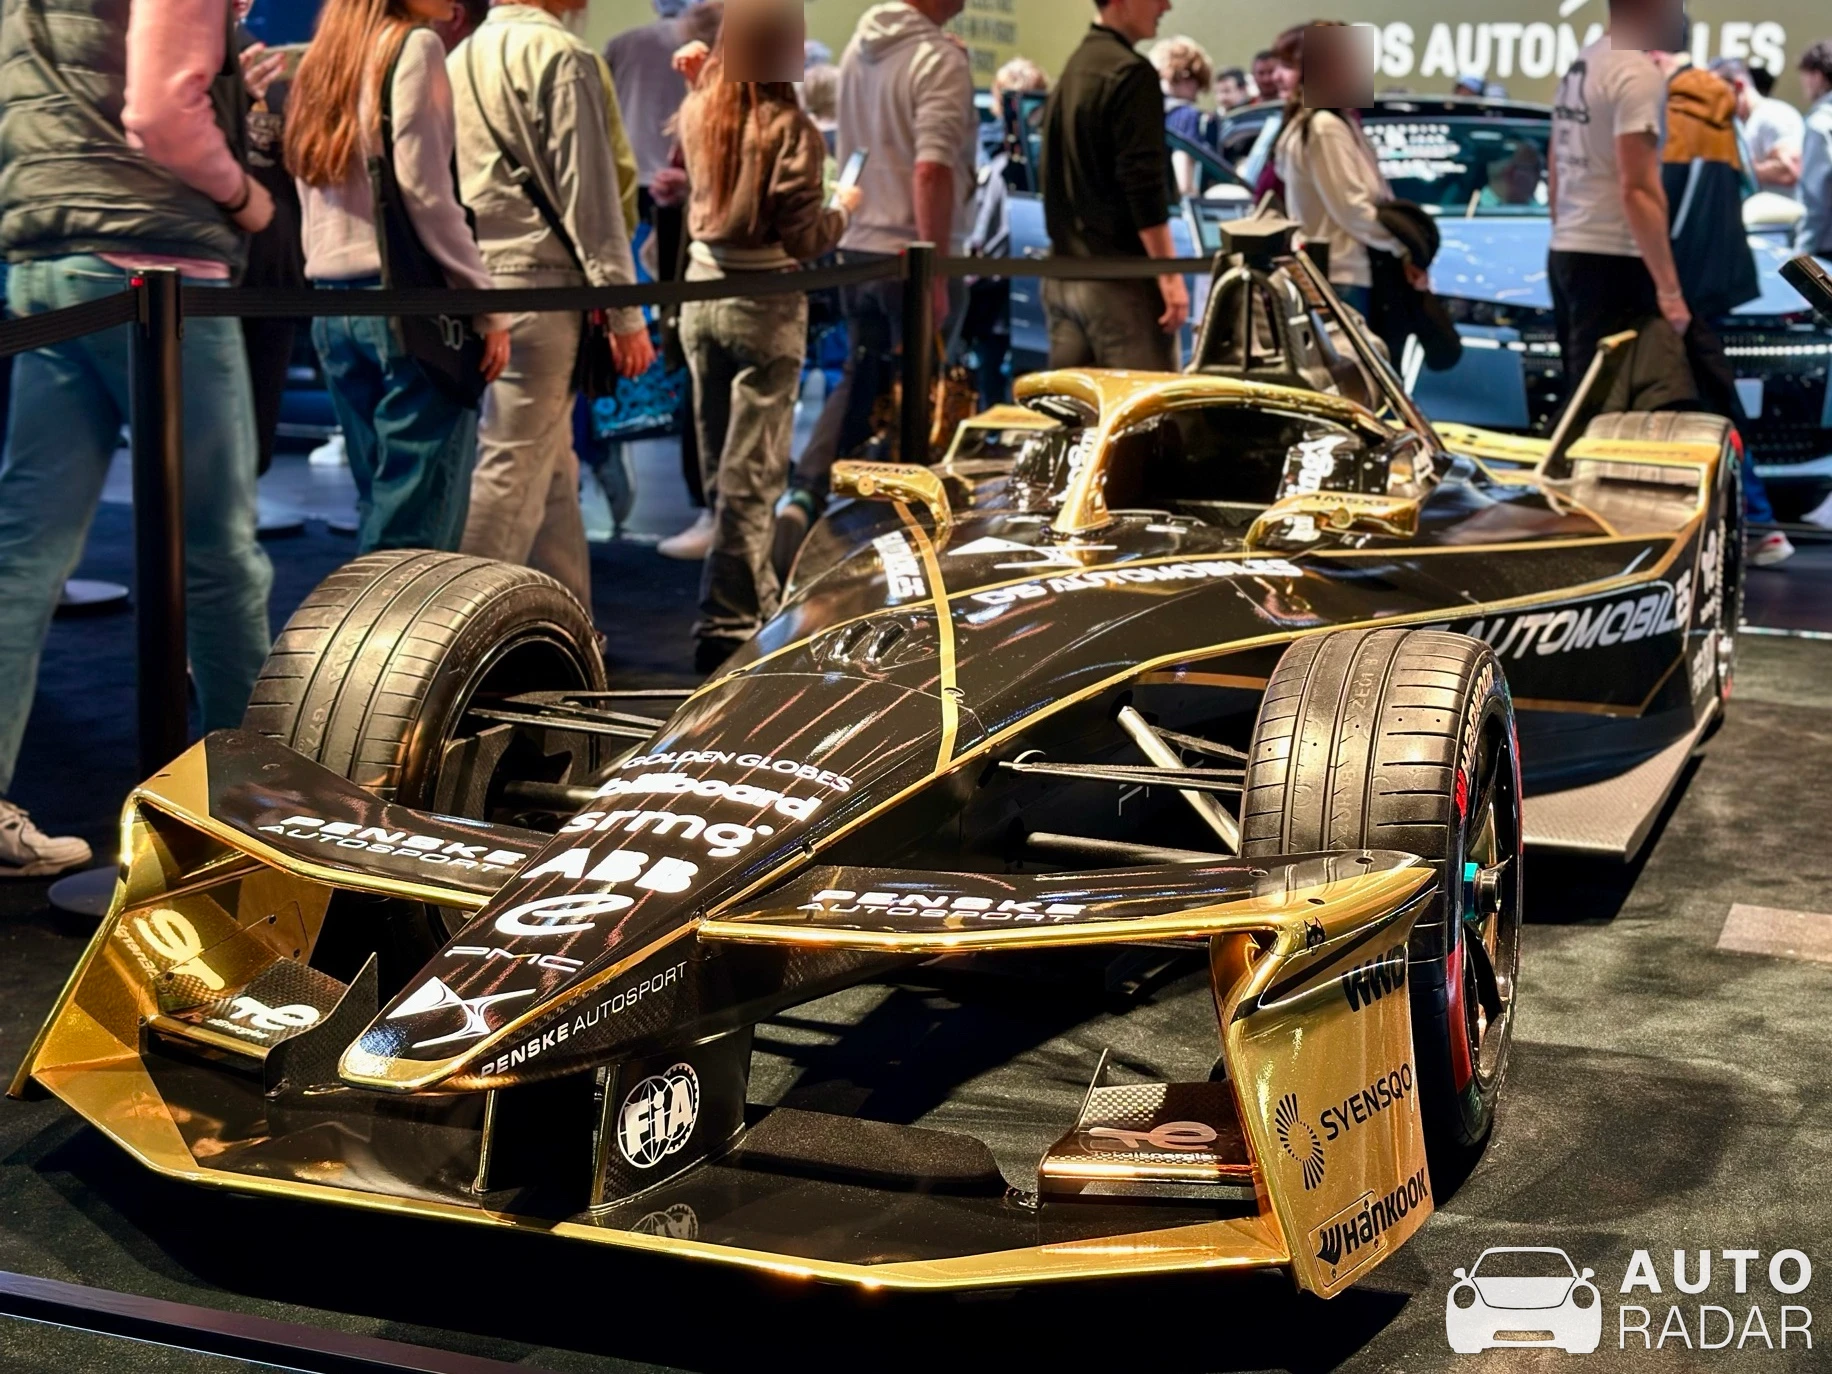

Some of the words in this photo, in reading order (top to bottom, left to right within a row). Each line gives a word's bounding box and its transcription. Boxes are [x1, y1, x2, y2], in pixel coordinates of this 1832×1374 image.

[621, 750, 736, 770] GOLDEN
[736, 753, 853, 792] GLOBES
[258, 825, 506, 873] AUTOSPORT
[280, 815, 527, 866] PENSKE
[521, 848, 700, 893] ABB
[797, 902, 1075, 922] AUTOSPORT
[812, 889, 1087, 915] PENSKE
[481, 1022, 569, 1077] PENSKE
[572, 961, 688, 1035] AUTOSPORT
[624, 1079, 693, 1156] FIA
[1320, 1062, 1412, 1141] SYENSQO
